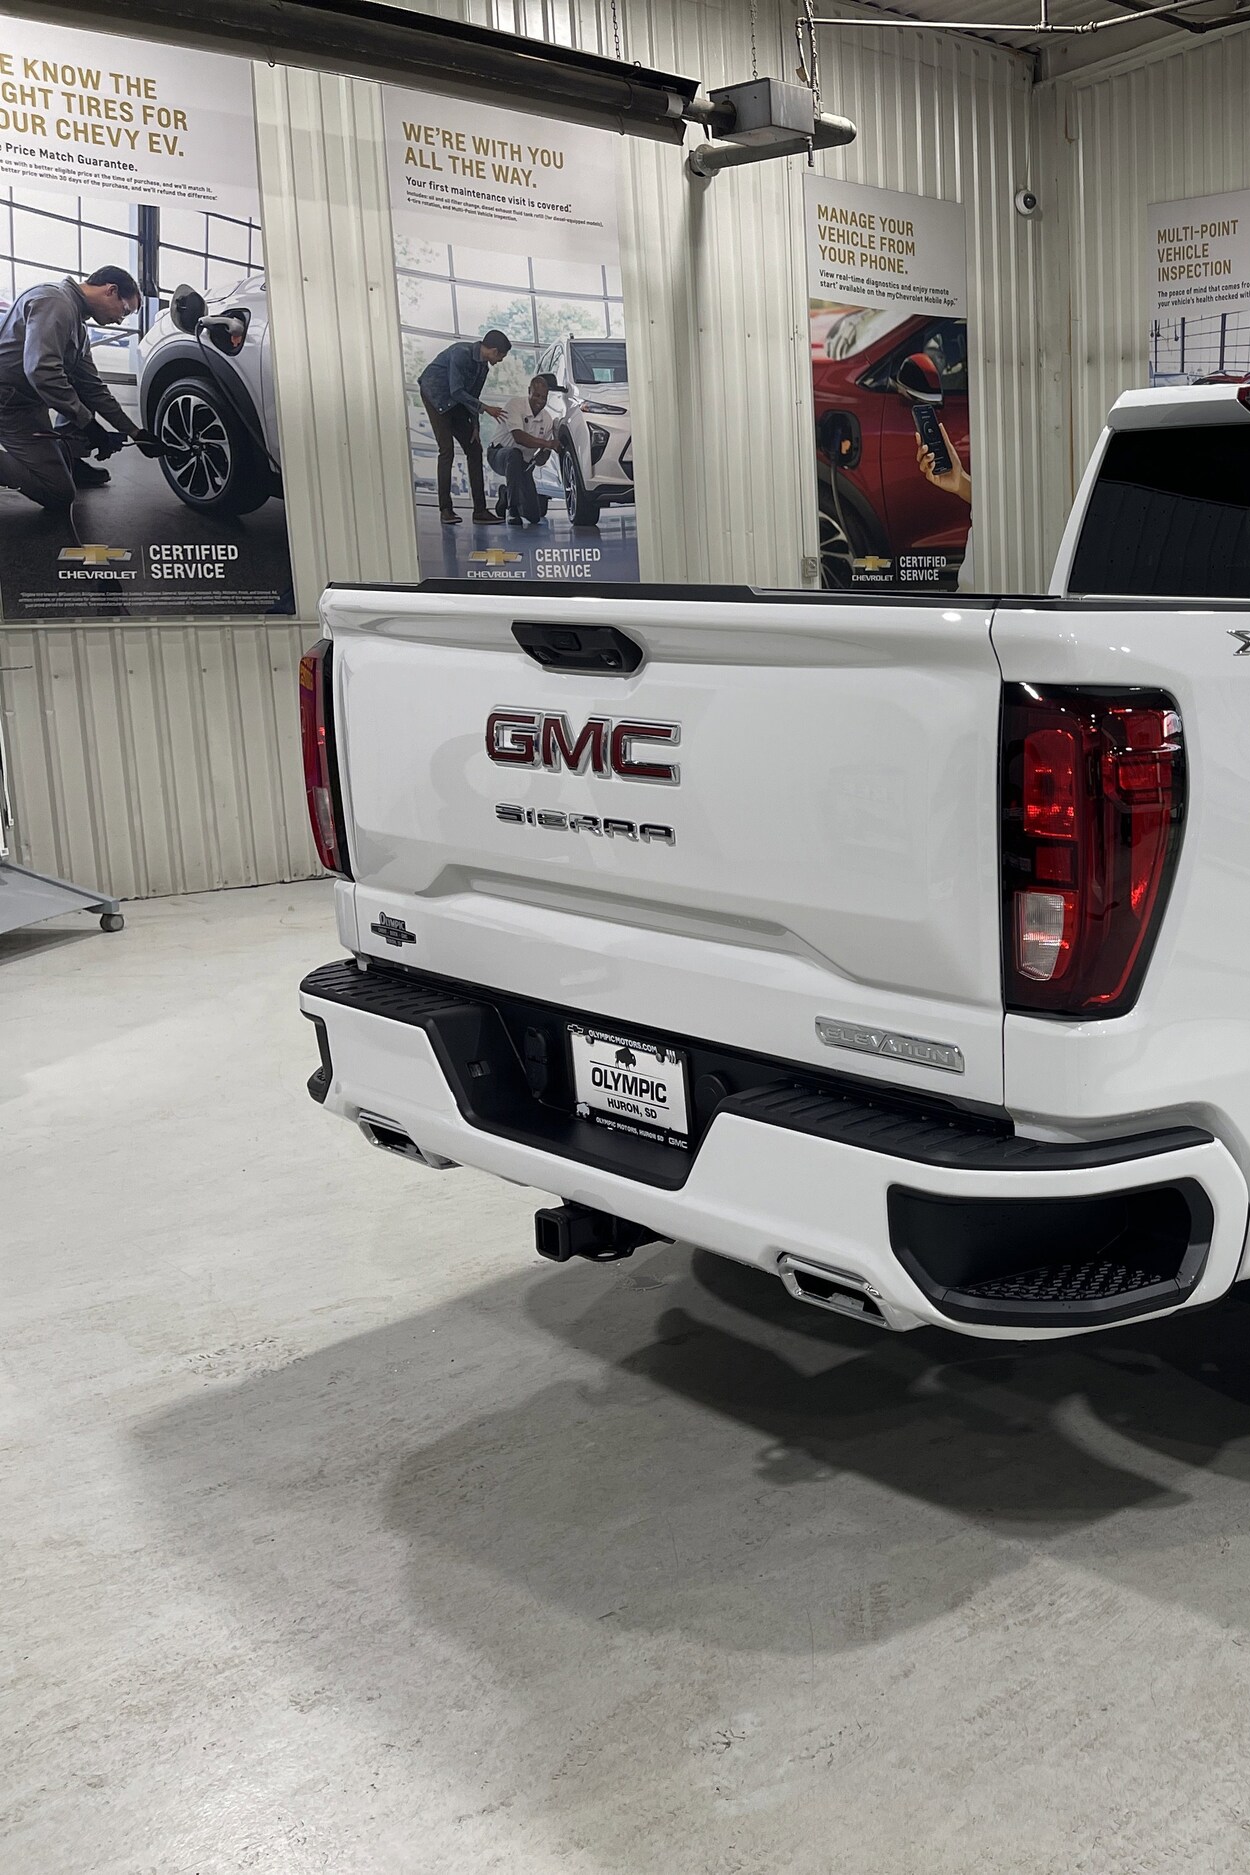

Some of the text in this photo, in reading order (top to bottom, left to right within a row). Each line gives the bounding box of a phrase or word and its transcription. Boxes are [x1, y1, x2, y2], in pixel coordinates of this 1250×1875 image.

[0, 53, 157, 100] E KNOW THE
[1, 82, 188, 131] GHT TIRES FOR
[0, 108, 184, 157] OUR CHEVY EV.
[402, 121, 564, 169] WE'RE WITH YOU
[6, 143, 36, 156] Price
[39, 148, 74, 163] Match
[77, 154, 138, 172] Guarantee.
[404, 147, 537, 188] ALL THE WAY.
[405, 176, 426, 187] Your
[428, 180, 449, 192] first
[451, 187, 506, 202] maintenance
[507, 196, 526, 206] visit
[528, 198, 535, 207] is
[817, 204, 914, 237] MANAGE YOUR
[1157, 219, 1239, 244] MULTI-POINT
[817, 224, 915, 256] VEHICLE FROM
[818, 244, 908, 275] YOUR PHONE.
[1157, 243, 1209, 264] VEHICLE
[819, 269, 834, 278] View
[835, 274, 864, 284] real-time
[865, 278, 899, 289] diagnostics
[912, 286, 928, 294] enjoy
[1158, 259, 1232, 282] INSPECTION
[839, 284, 865, 294] available
[875, 289, 885, 297] the
[886, 292, 923, 302] myChevrolet
[924, 296, 942, 304] Mobile
[1157, 301, 1170, 309] your
[1171, 297, 1194, 305] vehicle's
[1195, 295, 1213, 303] health
[1214, 292, 1238, 301] checked
[1169, 290, 1185, 298] peace
[1221, 283, 1240, 291] comes
[149, 545, 238, 561] CERTIFIED
[535, 548, 601, 562] CERTIFIED
[900, 556, 946, 568] CERTIFIED
[58, 570, 138, 580] CHEVROLET
[151, 563, 225, 579] SERVICE
[467, 570, 527, 578] CHEVROLET
[536, 564, 592, 578] SERVICE
[851, 574, 894, 582] CHEVROLET
[900, 569, 940, 581] SERVICE
[485, 704, 682, 787] GMC
[495, 802, 677, 847] SIERRA
[588, 1029, 658, 1053] OLYMPICMOTORS.COM
[826, 1027, 950, 1063] ELEVATION
[591, 1066, 667, 1104] OLYMPIC
[607, 1097, 657, 1120] HURON, SD
[595, 1116, 616, 1128] OLYMPIC
[668, 1137, 688, 1149] GMC
